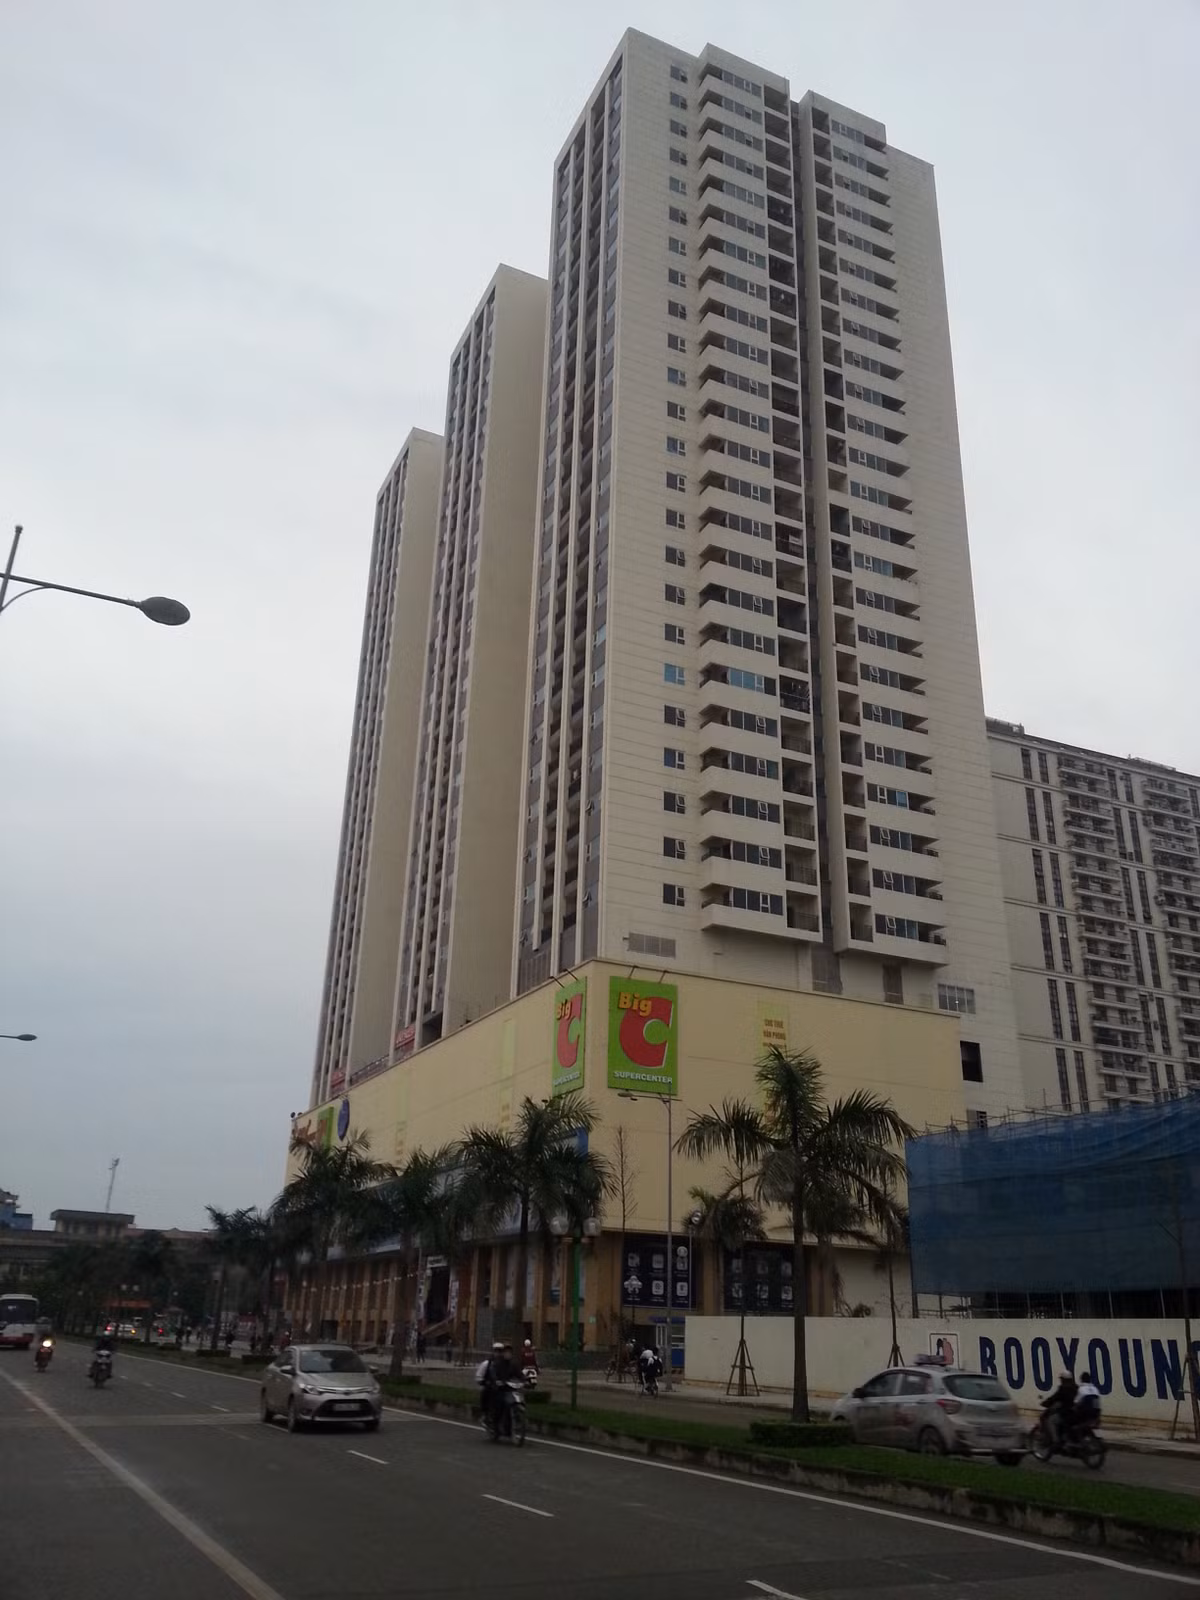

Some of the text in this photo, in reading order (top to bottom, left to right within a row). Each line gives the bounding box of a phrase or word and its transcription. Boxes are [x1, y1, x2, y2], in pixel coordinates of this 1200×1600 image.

[556, 998, 571, 1020] Big
[557, 993, 583, 1067] C
[618, 992, 673, 1068] Big C
[614, 1071, 673, 1083] SUPERCENTER
